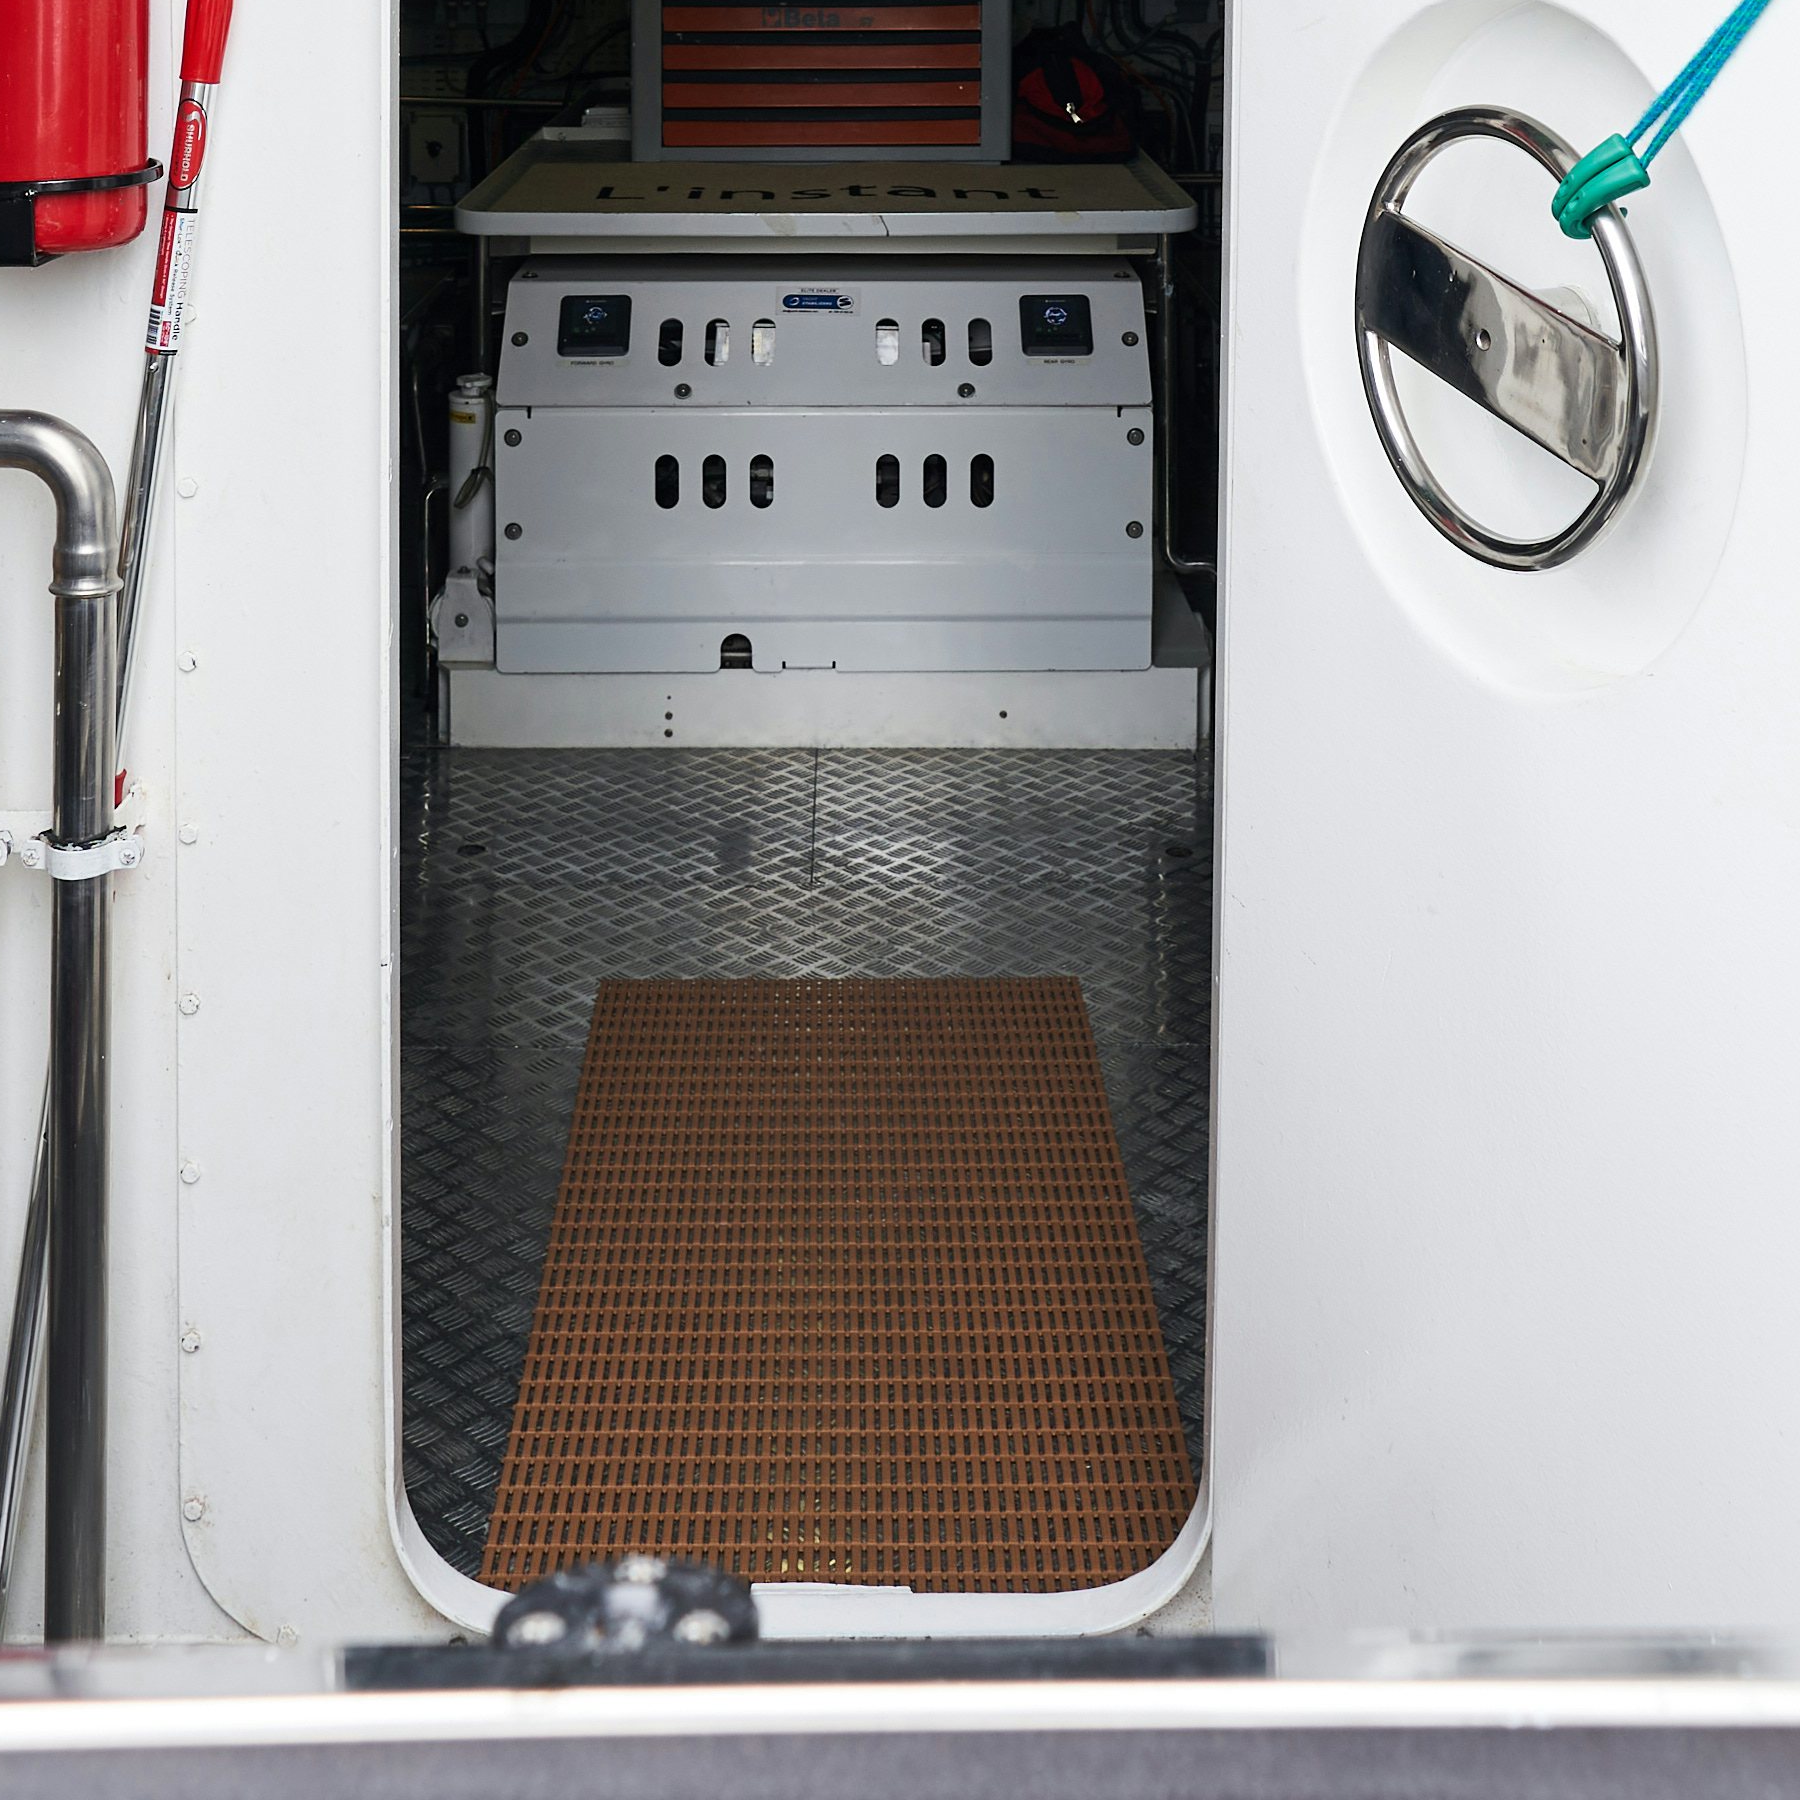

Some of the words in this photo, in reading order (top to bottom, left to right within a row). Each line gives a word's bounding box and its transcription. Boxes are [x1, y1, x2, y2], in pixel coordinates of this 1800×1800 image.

[595, 184, 1059, 200] L'instant
[178, 219, 195, 299] TELESCOPING
[172, 303, 184, 341] Handle
